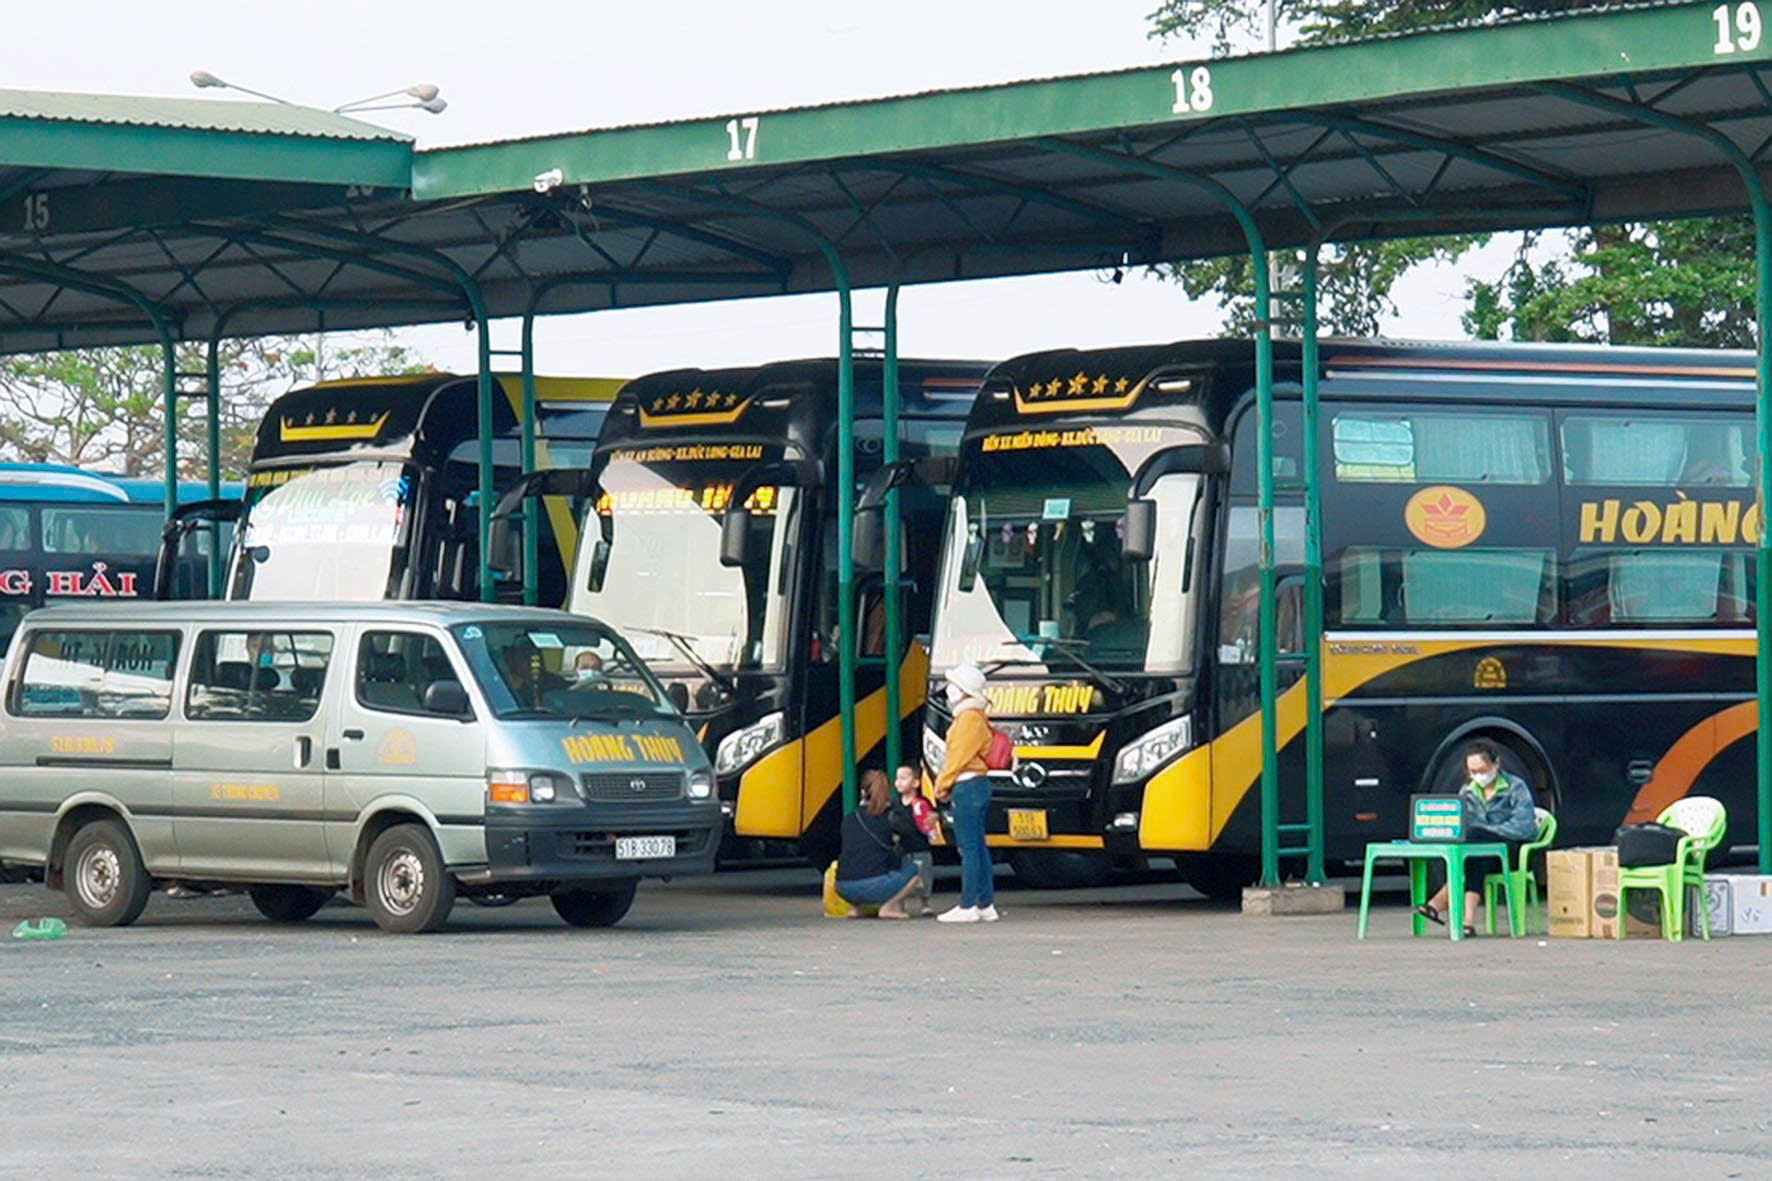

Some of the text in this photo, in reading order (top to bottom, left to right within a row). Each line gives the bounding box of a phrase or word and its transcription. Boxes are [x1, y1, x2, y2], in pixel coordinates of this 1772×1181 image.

[1712, 1, 1762, 54] 19
[1171, 66, 1213, 114] 18
[726, 116, 759, 160] 17
[23, 193, 49, 231] 15
[46, 561, 138, 596] HẢI
[1043, 679, 1094, 713] THỦY
